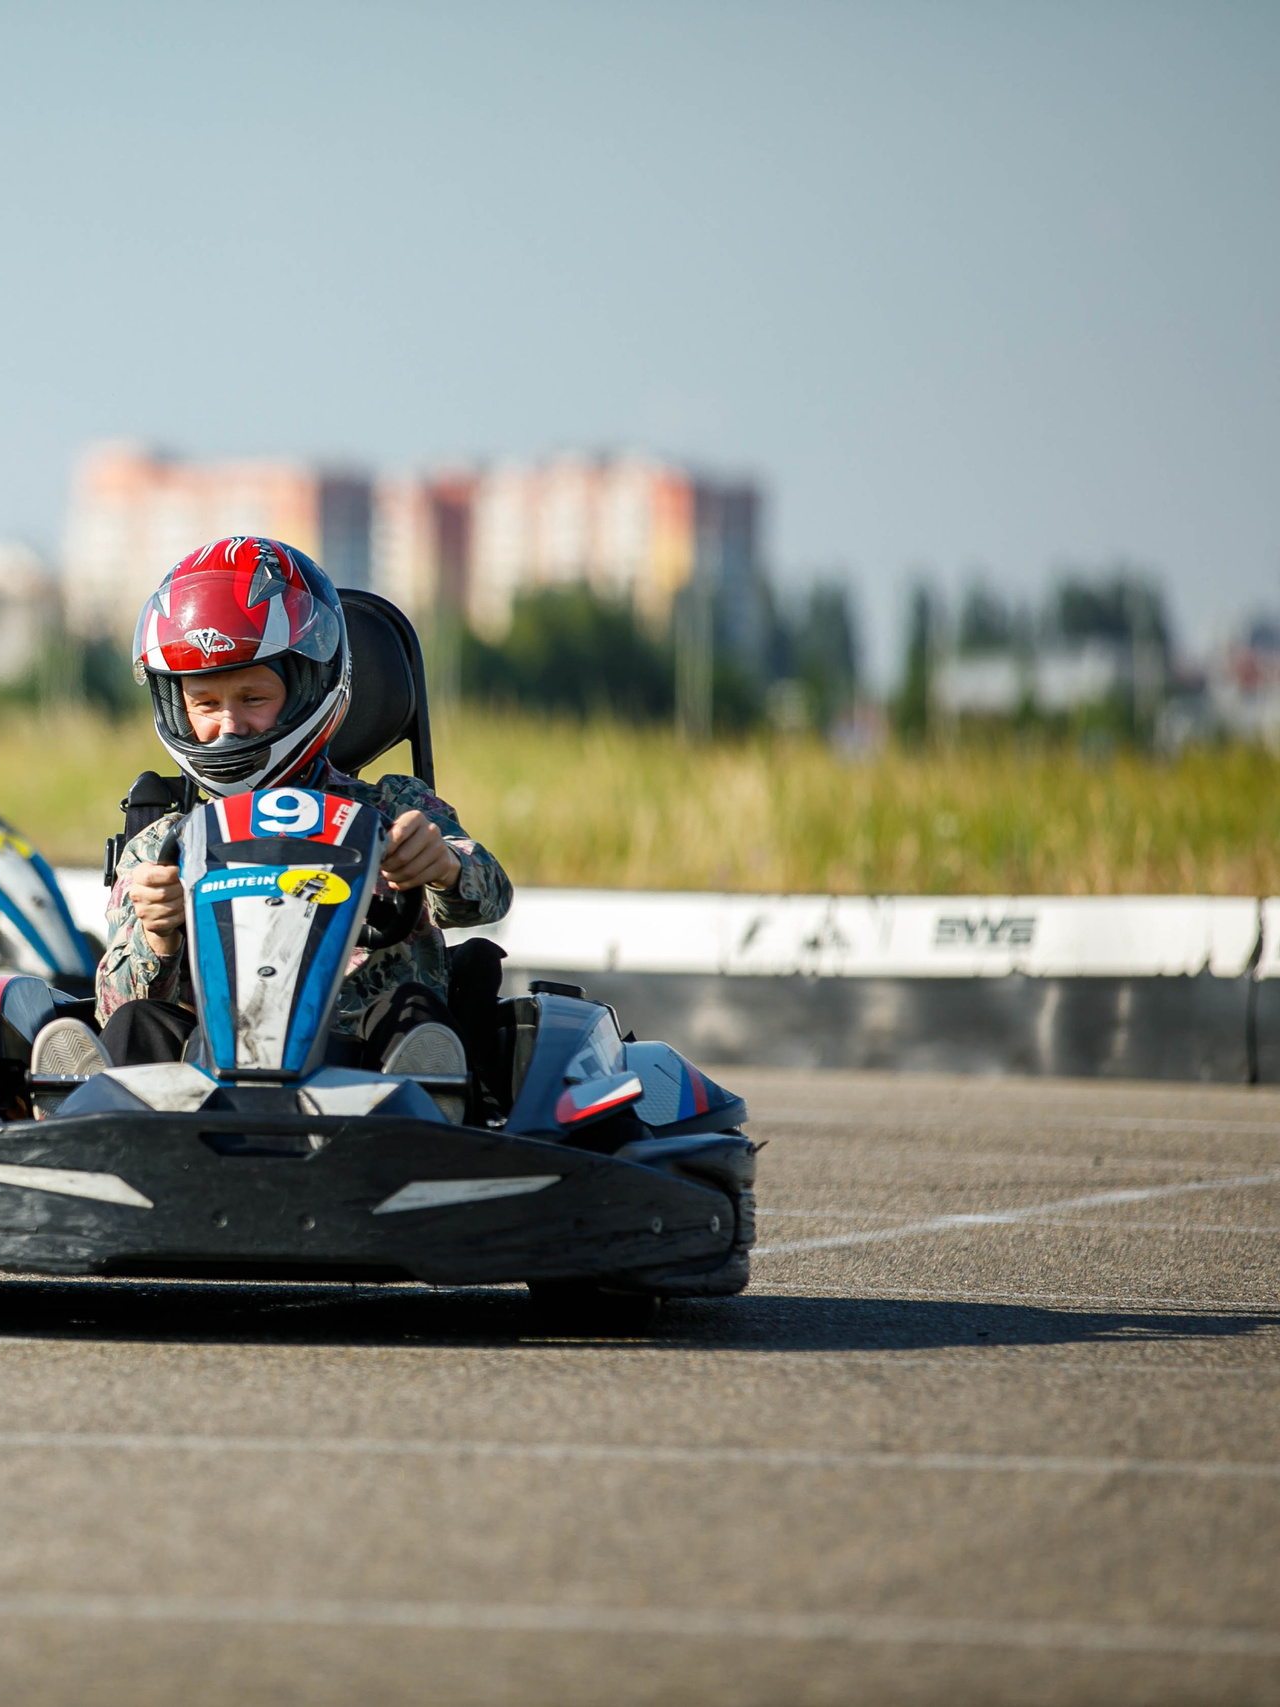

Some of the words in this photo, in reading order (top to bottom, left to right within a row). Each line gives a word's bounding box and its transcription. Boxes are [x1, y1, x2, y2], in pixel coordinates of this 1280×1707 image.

[205, 644, 230, 653] VEGA
[257, 788, 320, 833] 9
[200, 875, 276, 894] BILSTEIN
